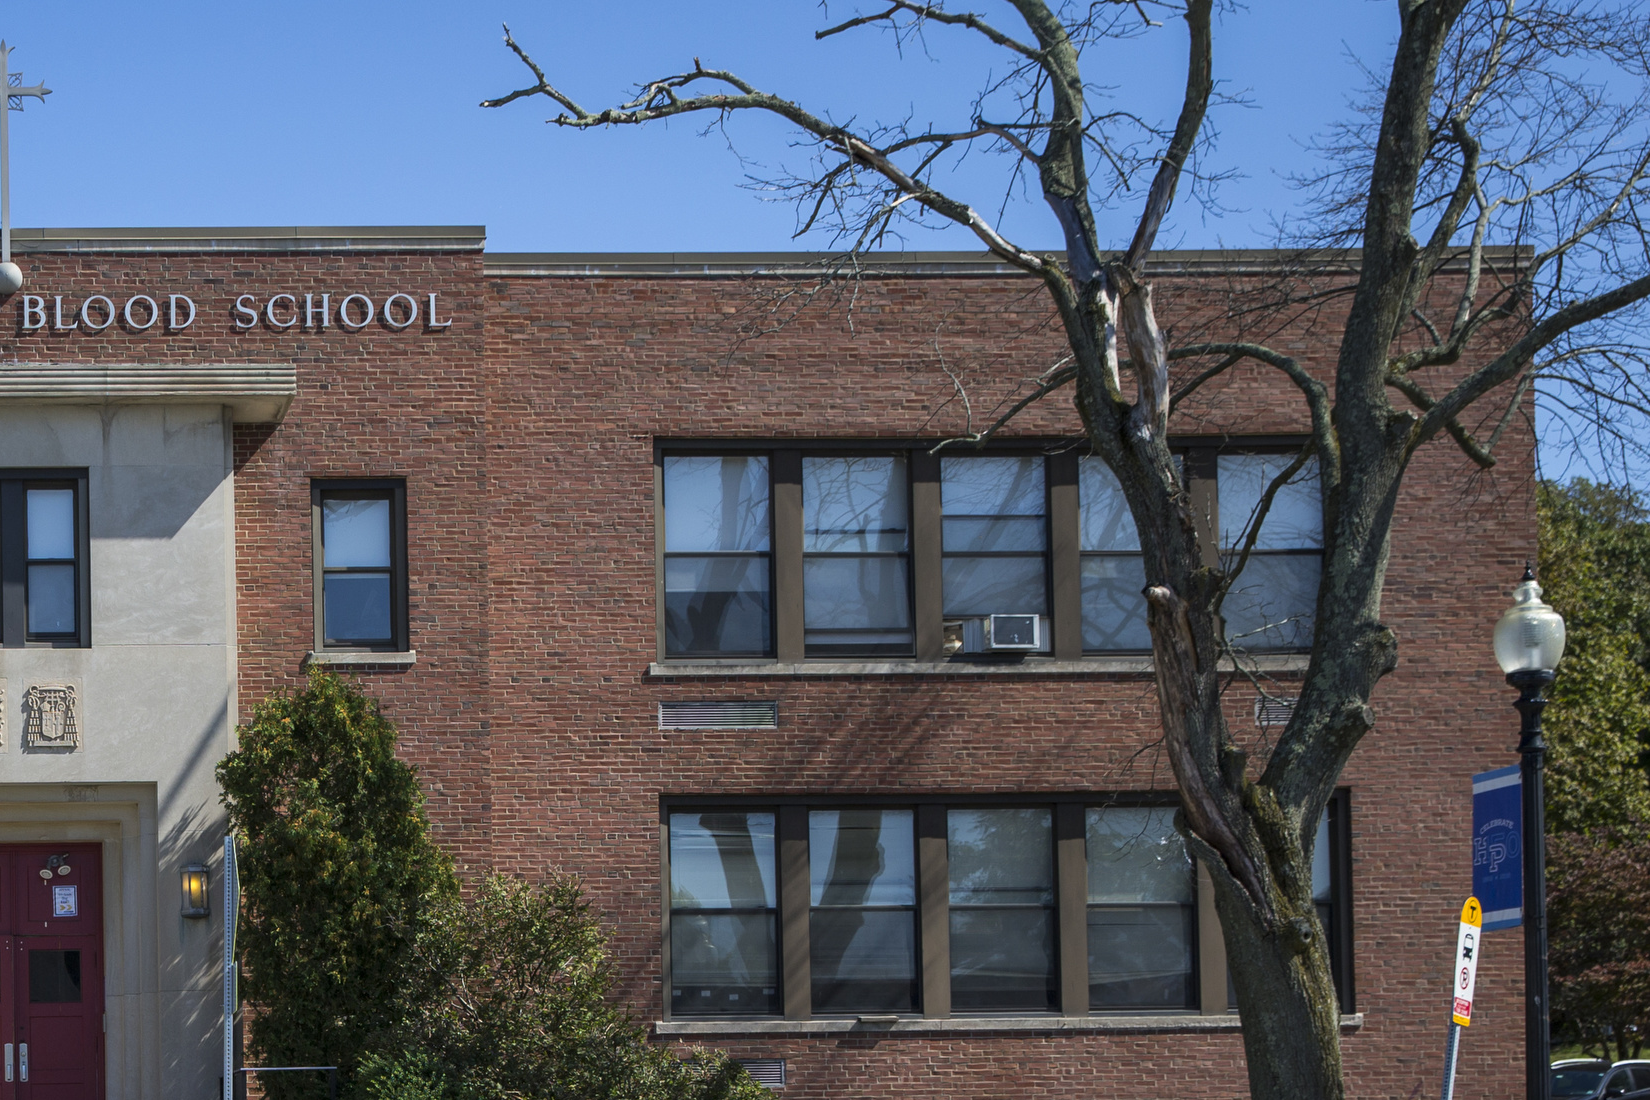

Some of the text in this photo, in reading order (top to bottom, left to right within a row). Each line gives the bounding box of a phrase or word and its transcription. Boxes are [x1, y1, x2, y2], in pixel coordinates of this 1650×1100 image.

[21, 295, 196, 330] BLOOD
[235, 293, 452, 329] SCHOOL
[1480, 818, 1514, 834] CELEBRATE
